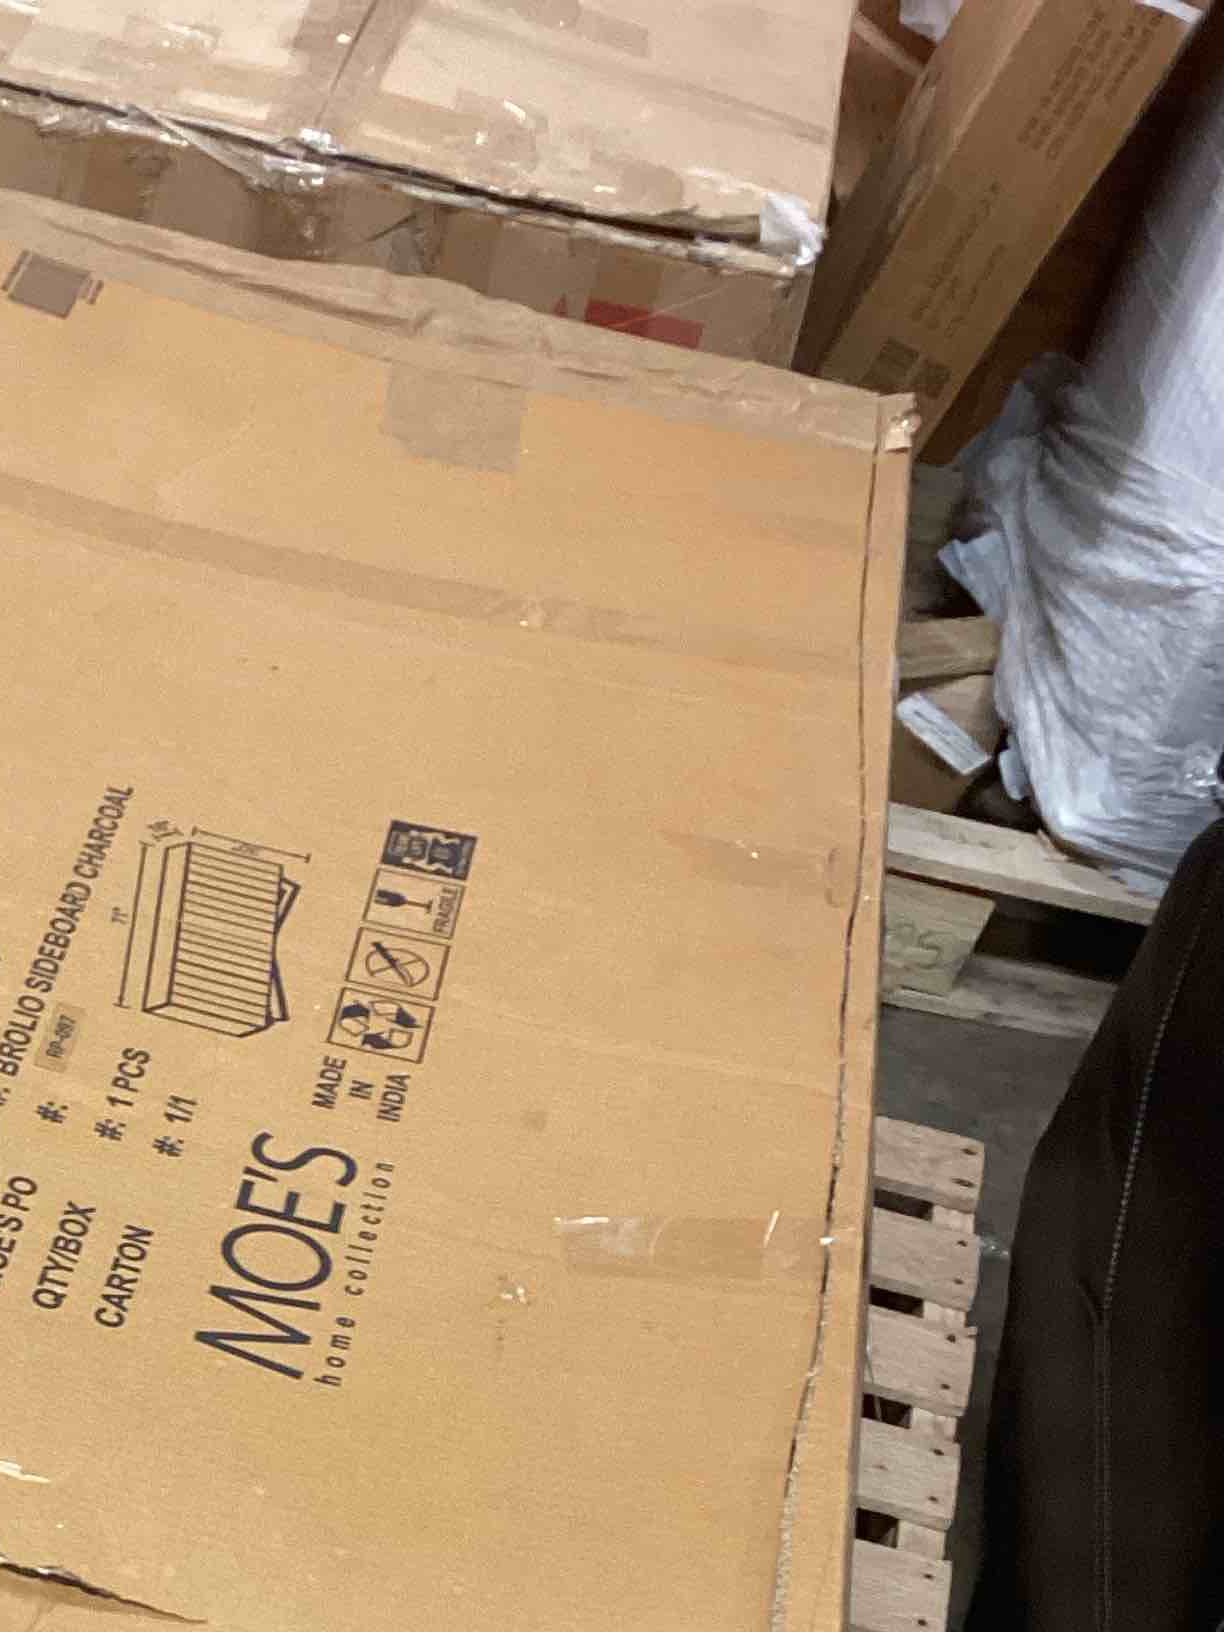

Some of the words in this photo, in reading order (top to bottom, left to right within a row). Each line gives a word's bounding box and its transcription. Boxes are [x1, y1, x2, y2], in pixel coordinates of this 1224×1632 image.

[26, 881, 92, 994] SIDEBOARD
[73, 783, 135, 880] CHARCOAL
[431, 886, 460, 936] FRAGILE
[112, 1046, 152, 1094] PCS
[312, 1055, 348, 1111] MADE
[348, 1079, 375, 1100] IN
[106, 1091, 133, 1110] 1
[376, 1072, 412, 1123] INDIA
[0, 1175, 39, 1213] PO
[93, 1224, 155, 1330] CARTON
[162, 1094, 198, 1125] 1/1
[31, 1200, 98, 1311] QTY/BOX
[194, 1131, 359, 1381] MOE'S
[314, 1315, 357, 1387] home
[345, 1161, 395, 1296] collection
